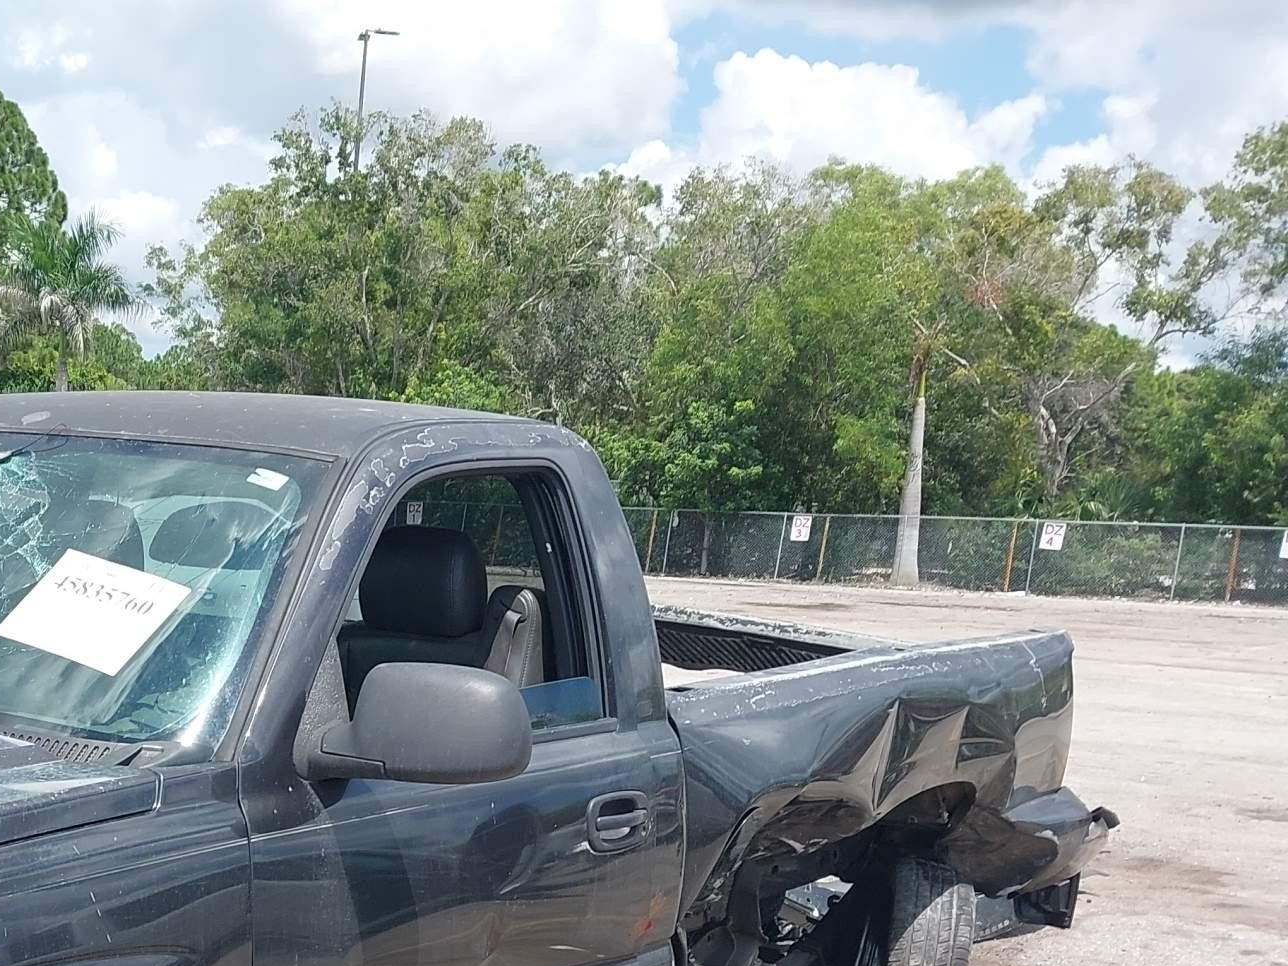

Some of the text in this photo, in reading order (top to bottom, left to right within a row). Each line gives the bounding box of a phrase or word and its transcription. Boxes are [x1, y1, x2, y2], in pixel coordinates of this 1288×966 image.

[409, 503, 422, 513] DZ
[794, 517, 810, 528] DZ
[795, 529, 802, 539] 3
[1045, 523, 1064, 536] DZ
[1046, 536, 1054, 546] 4
[54, 575, 155, 616] 45835760
